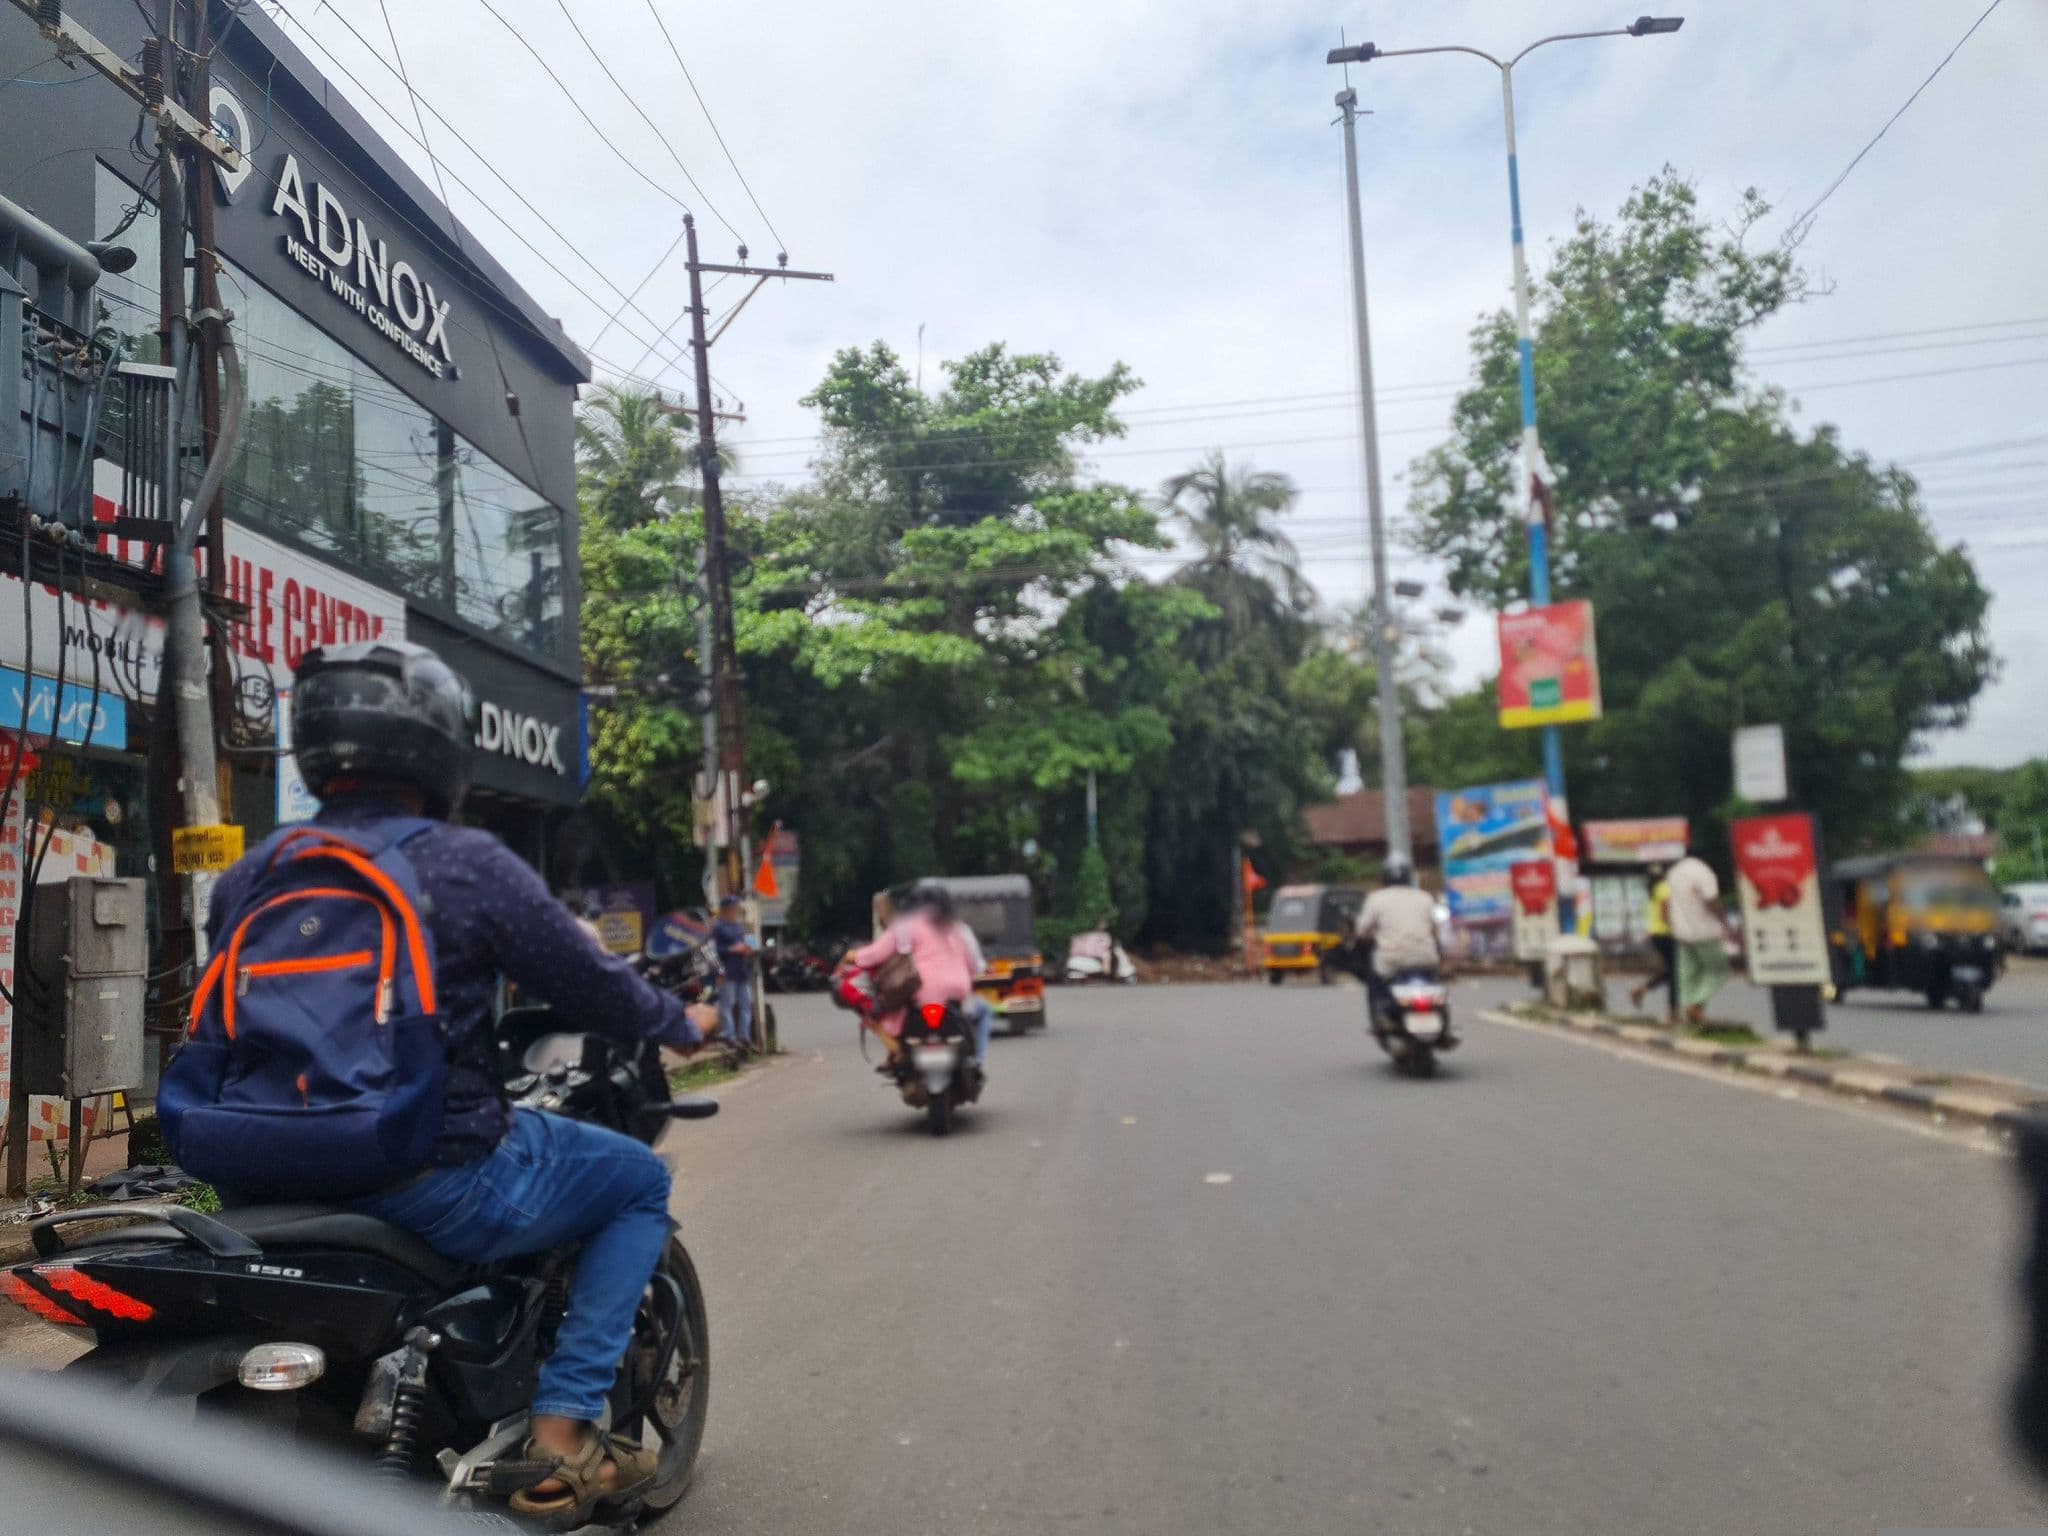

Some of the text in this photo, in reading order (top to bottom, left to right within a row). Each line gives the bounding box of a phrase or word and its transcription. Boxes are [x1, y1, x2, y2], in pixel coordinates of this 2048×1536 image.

[272, 153, 451, 363] ADNOX
[287, 234, 443, 379] MEET WITH CONFIDENCE
[12, 685, 107, 731] vivo
[475, 701, 562, 775] DNOX
[249, 1264, 303, 1278] 150
